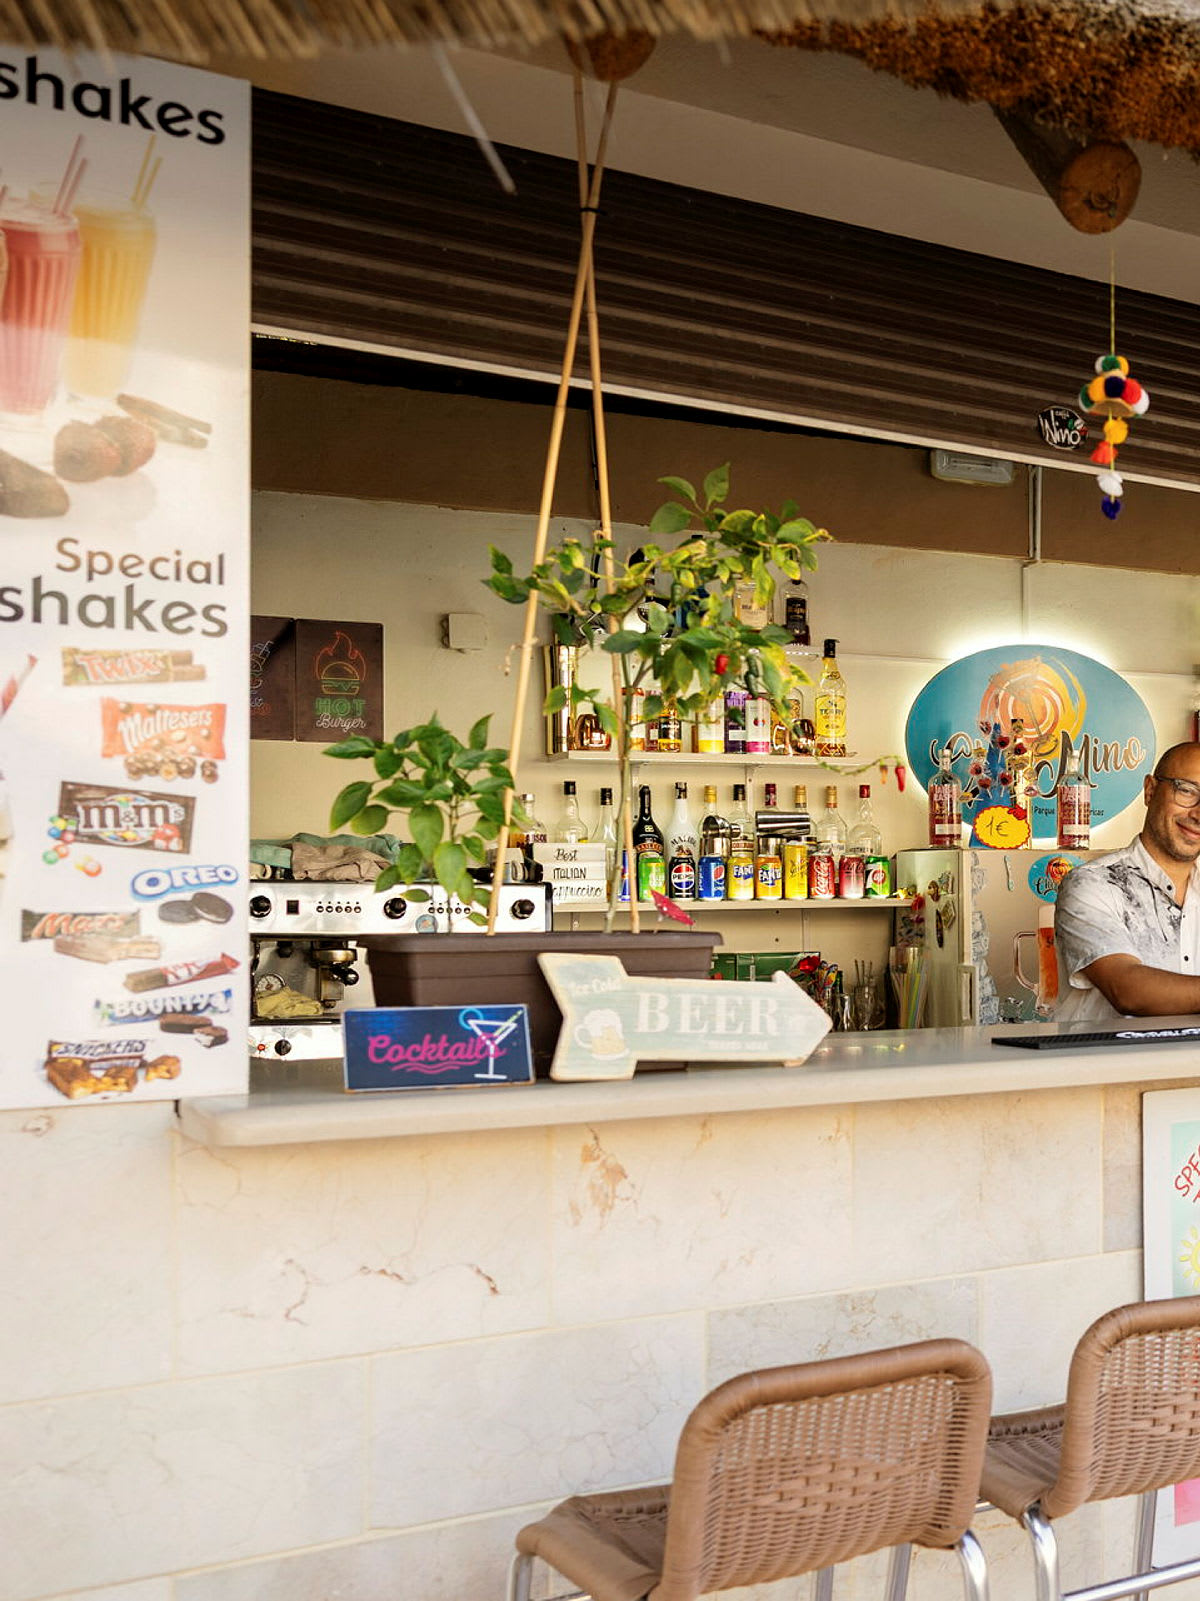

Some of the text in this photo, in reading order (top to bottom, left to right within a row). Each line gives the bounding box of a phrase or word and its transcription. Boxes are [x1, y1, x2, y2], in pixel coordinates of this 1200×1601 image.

[56, 537, 226, 584] Special
[0, 575, 228, 638] shakes
[315, 697, 366, 716] HOT
[118, 709, 212, 753] Maltesers
[316, 713, 367, 732] Burger
[554, 848, 577, 861] Best
[132, 866, 238, 897] OREO
[635, 991, 780, 1035] BEER
[367, 1033, 507, 1064] Cocktails
